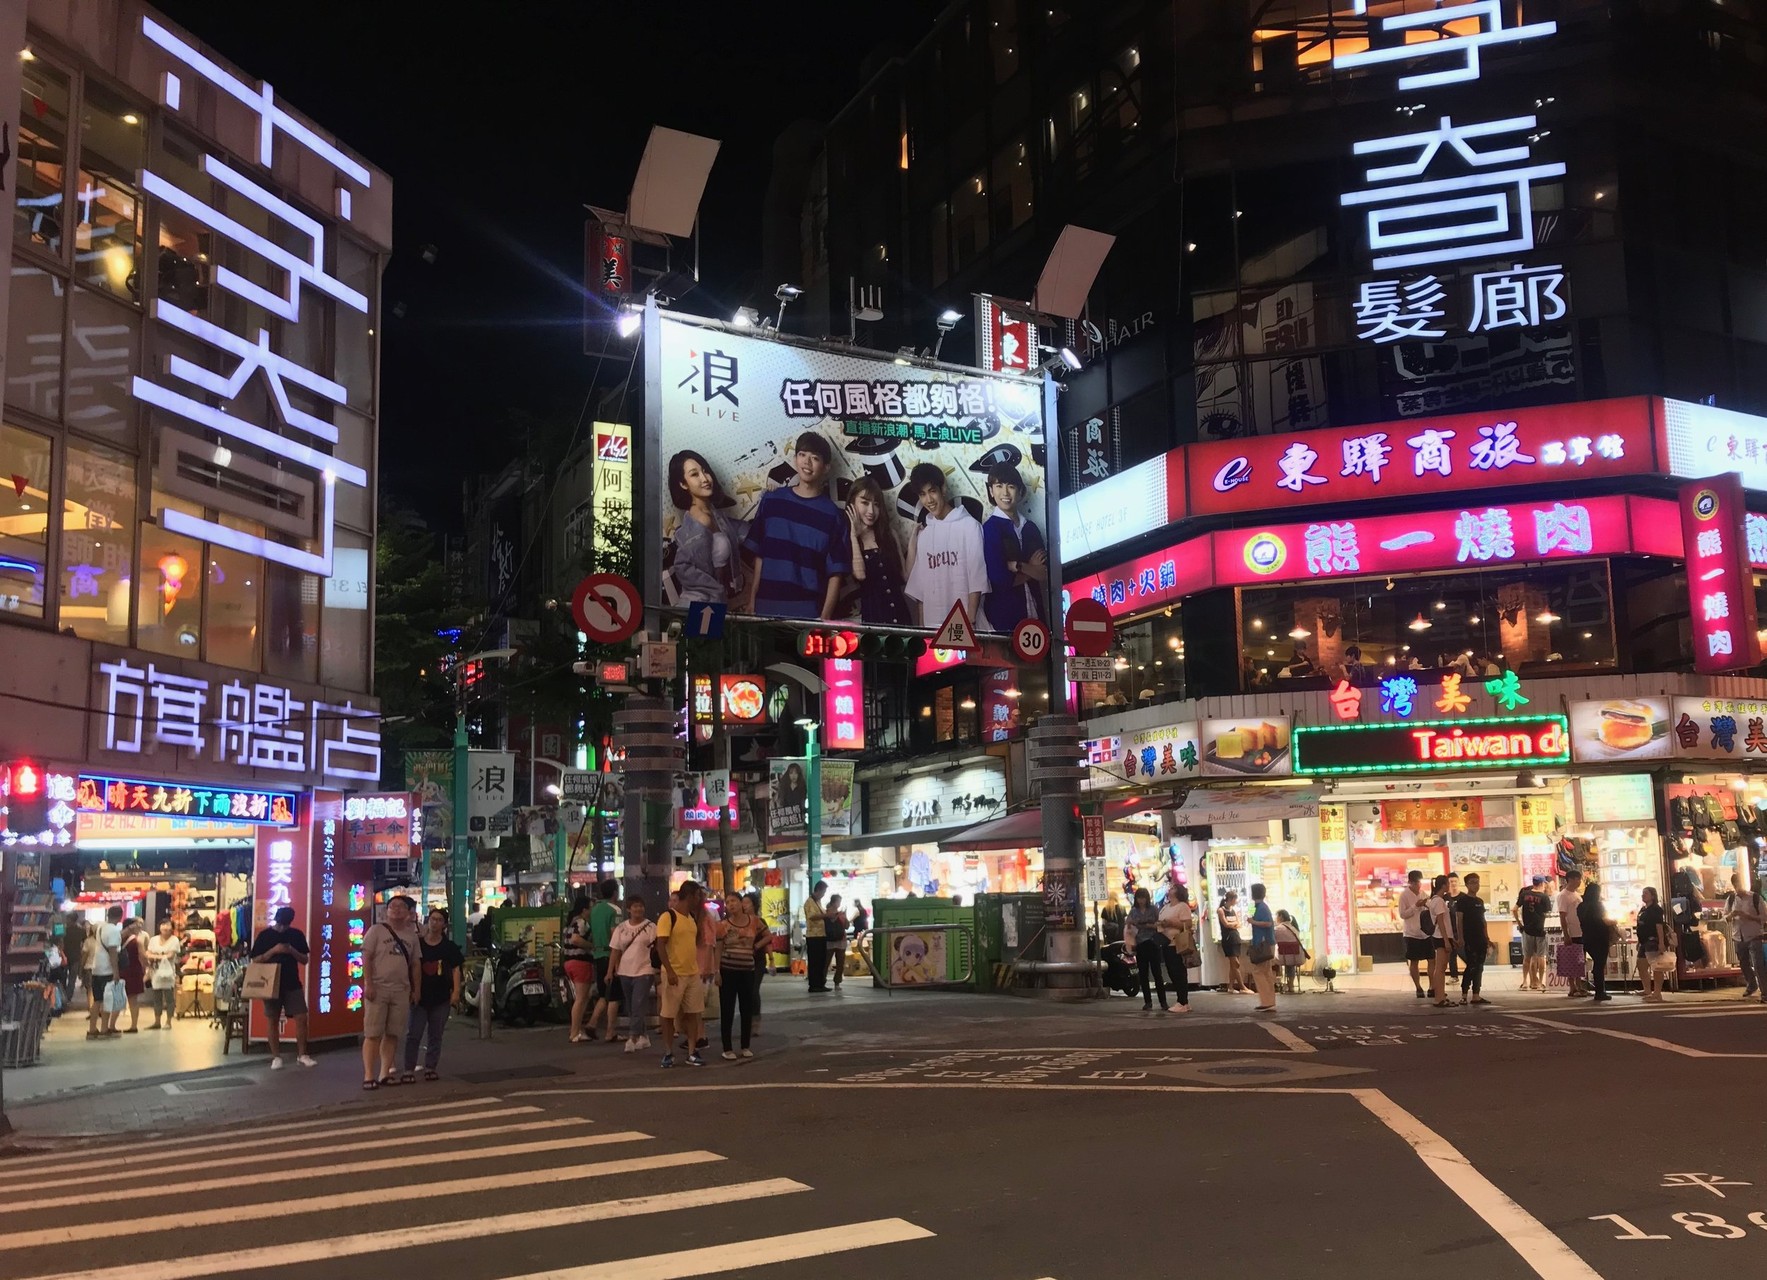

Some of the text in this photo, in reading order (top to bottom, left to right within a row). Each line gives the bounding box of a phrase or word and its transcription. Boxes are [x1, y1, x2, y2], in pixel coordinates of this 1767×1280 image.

[1352, 263, 1568, 344] 髮廊
[678, 349, 740, 406] 浪
[691, 404, 741, 422] LIVE
[782, 380, 996, 417] 任何風格都夠格!
[1276, 420, 1537, 492] 東驛商旅
[1305, 502, 1594, 575] 熊一燒肉
[1697, 529, 1734, 657] 熊一燒肉
[947, 623, 965, 643] 慢
[1022, 632, 1041, 649] 30
[1330, 669, 1530, 719] 台灣美味
[99, 658, 382, 782] 旗艦店
[1412, 728, 1532, 760] Taiwan
[1123, 740, 1199, 779] 台灣美味
[472, 765, 506, 794] 浪
[345, 797, 407, 822] 劉福記
[901, 798, 935, 819] STAR
[1320, 806, 1344, 823] 歡迎
[348, 820, 404, 838] 手工傘
[1320, 825, 1345, 841] 試吃
[1522, 819, 1549, 836] 試吃
[1660, 1172, 1754, 1198] 平
[1587, 1211, 1767, 1240] 18
